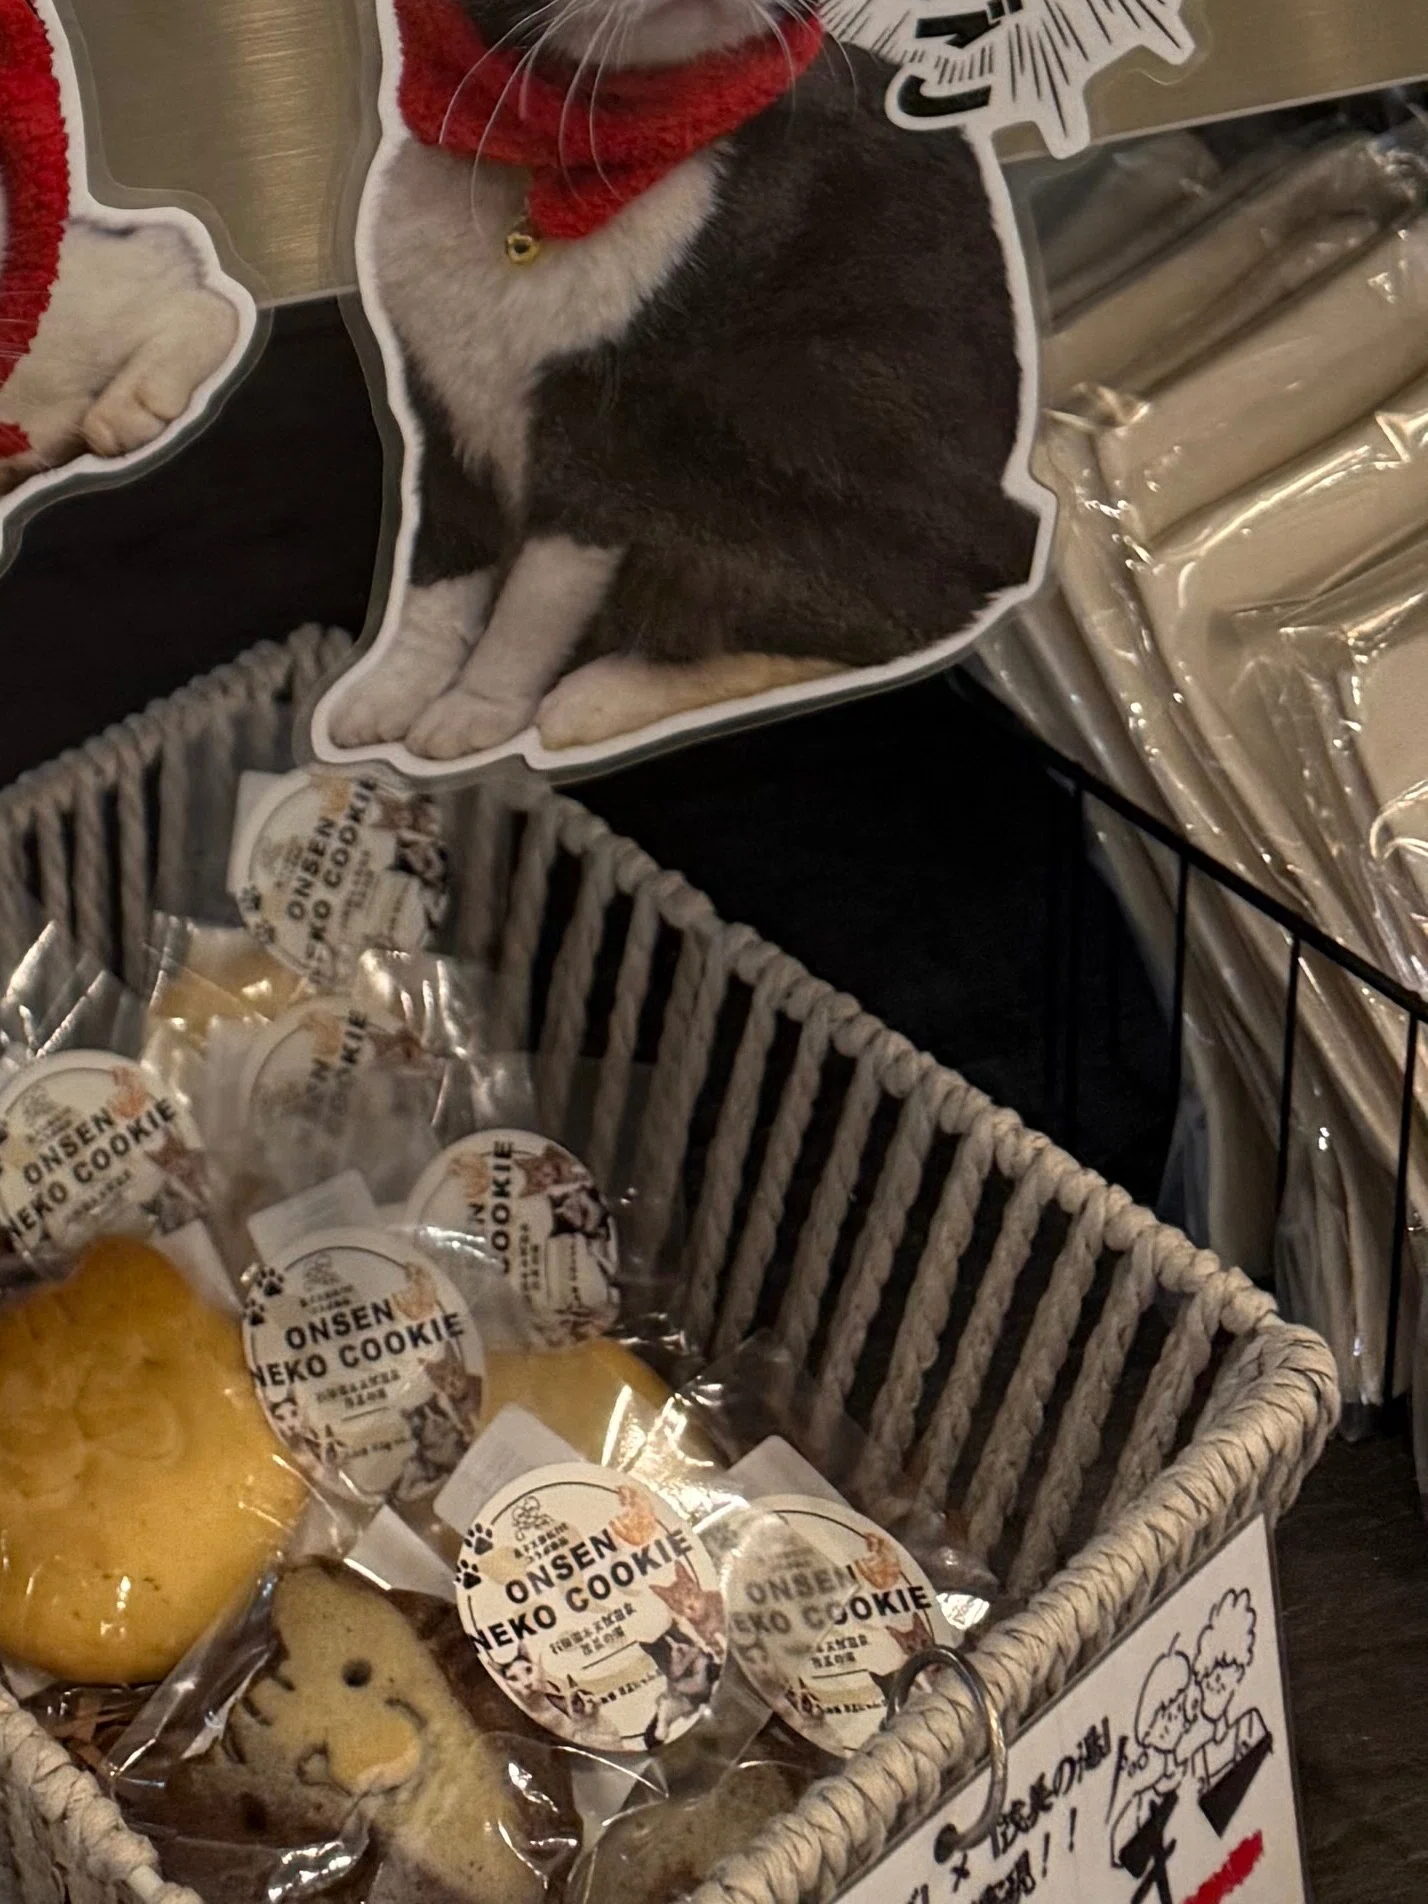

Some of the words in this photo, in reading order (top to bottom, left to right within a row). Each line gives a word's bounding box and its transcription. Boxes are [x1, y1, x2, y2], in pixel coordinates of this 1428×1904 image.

[21, 1103, 117, 1188] ONSEN
[73, 1096, 180, 1187] COOKIE
[249, 1354, 328, 1389] NEKO
[338, 1312, 466, 1370] COOKIE
[283, 1298, 395, 1350] ONSEN
[467, 1607, 558, 1655] NEKO
[566, 1527, 696, 1616] COOKIE
[505, 1526, 618, 1605] ONSEN
[746, 1564, 855, 1607] ONSEN
[804, 1584, 934, 1631] COOKIE
